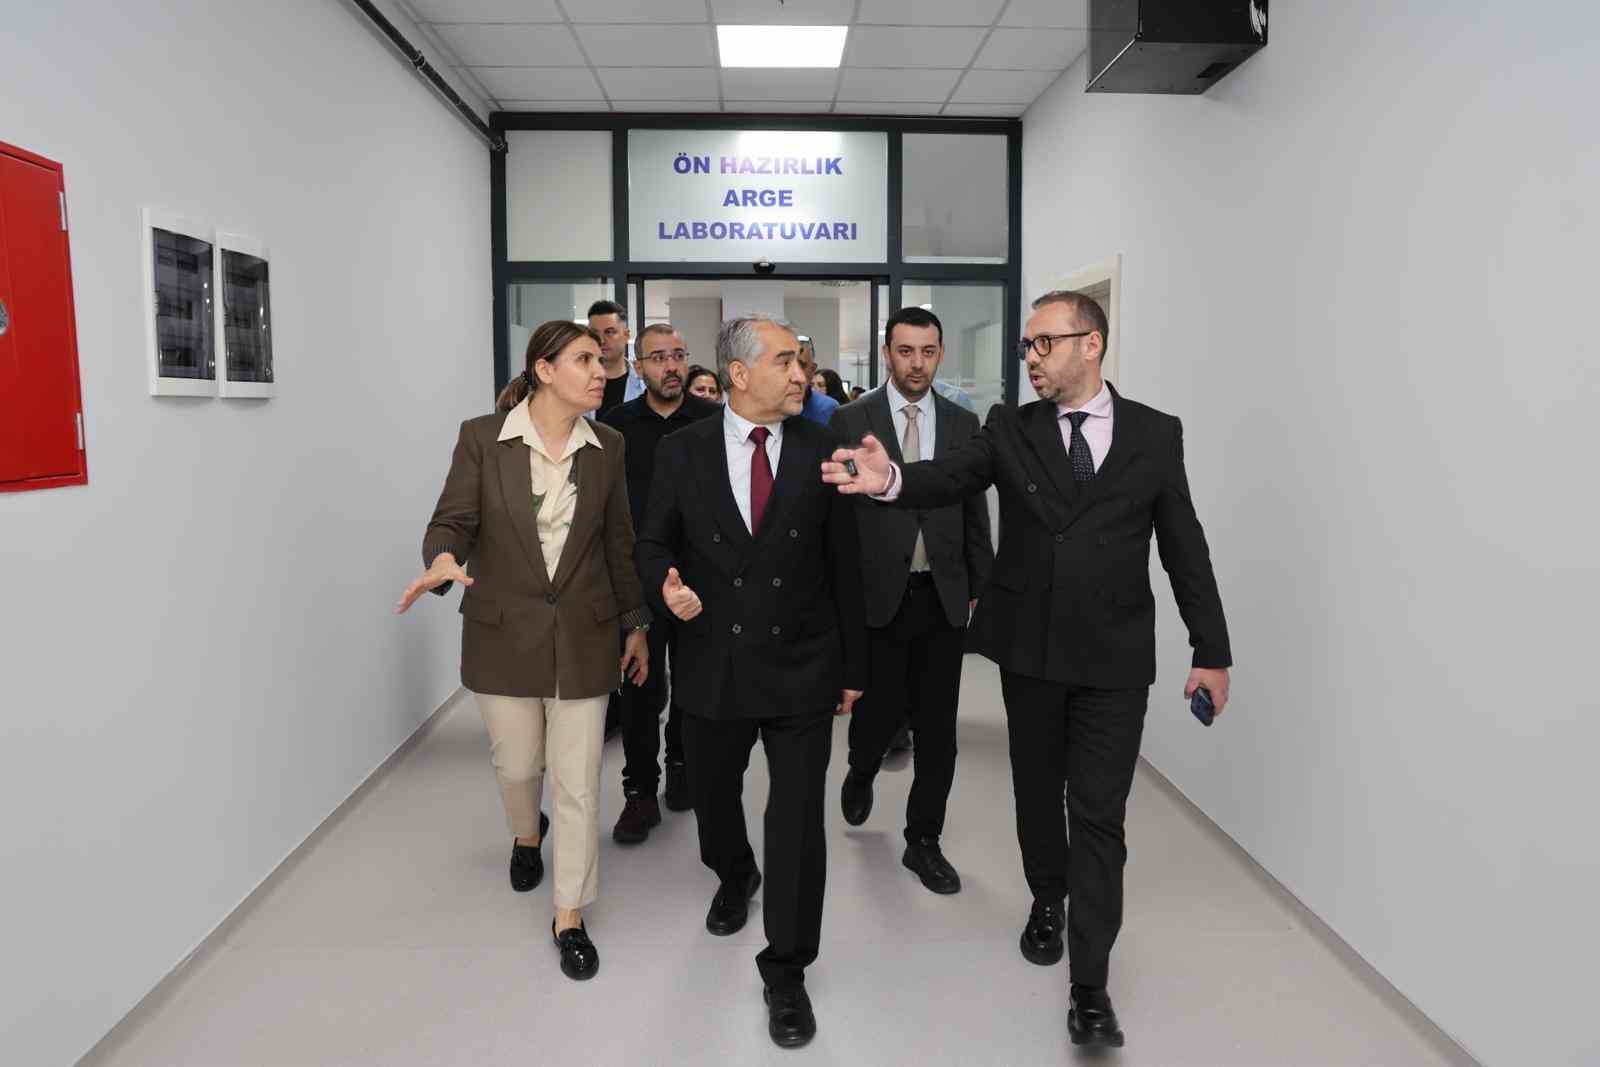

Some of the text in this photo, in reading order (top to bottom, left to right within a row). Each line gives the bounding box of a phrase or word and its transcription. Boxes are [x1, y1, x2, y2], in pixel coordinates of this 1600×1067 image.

[673, 152, 843, 175] ÖN HAZIRLIK
[723, 189, 793, 207] ARGE
[658, 222, 857, 240] LABORATUVARI
